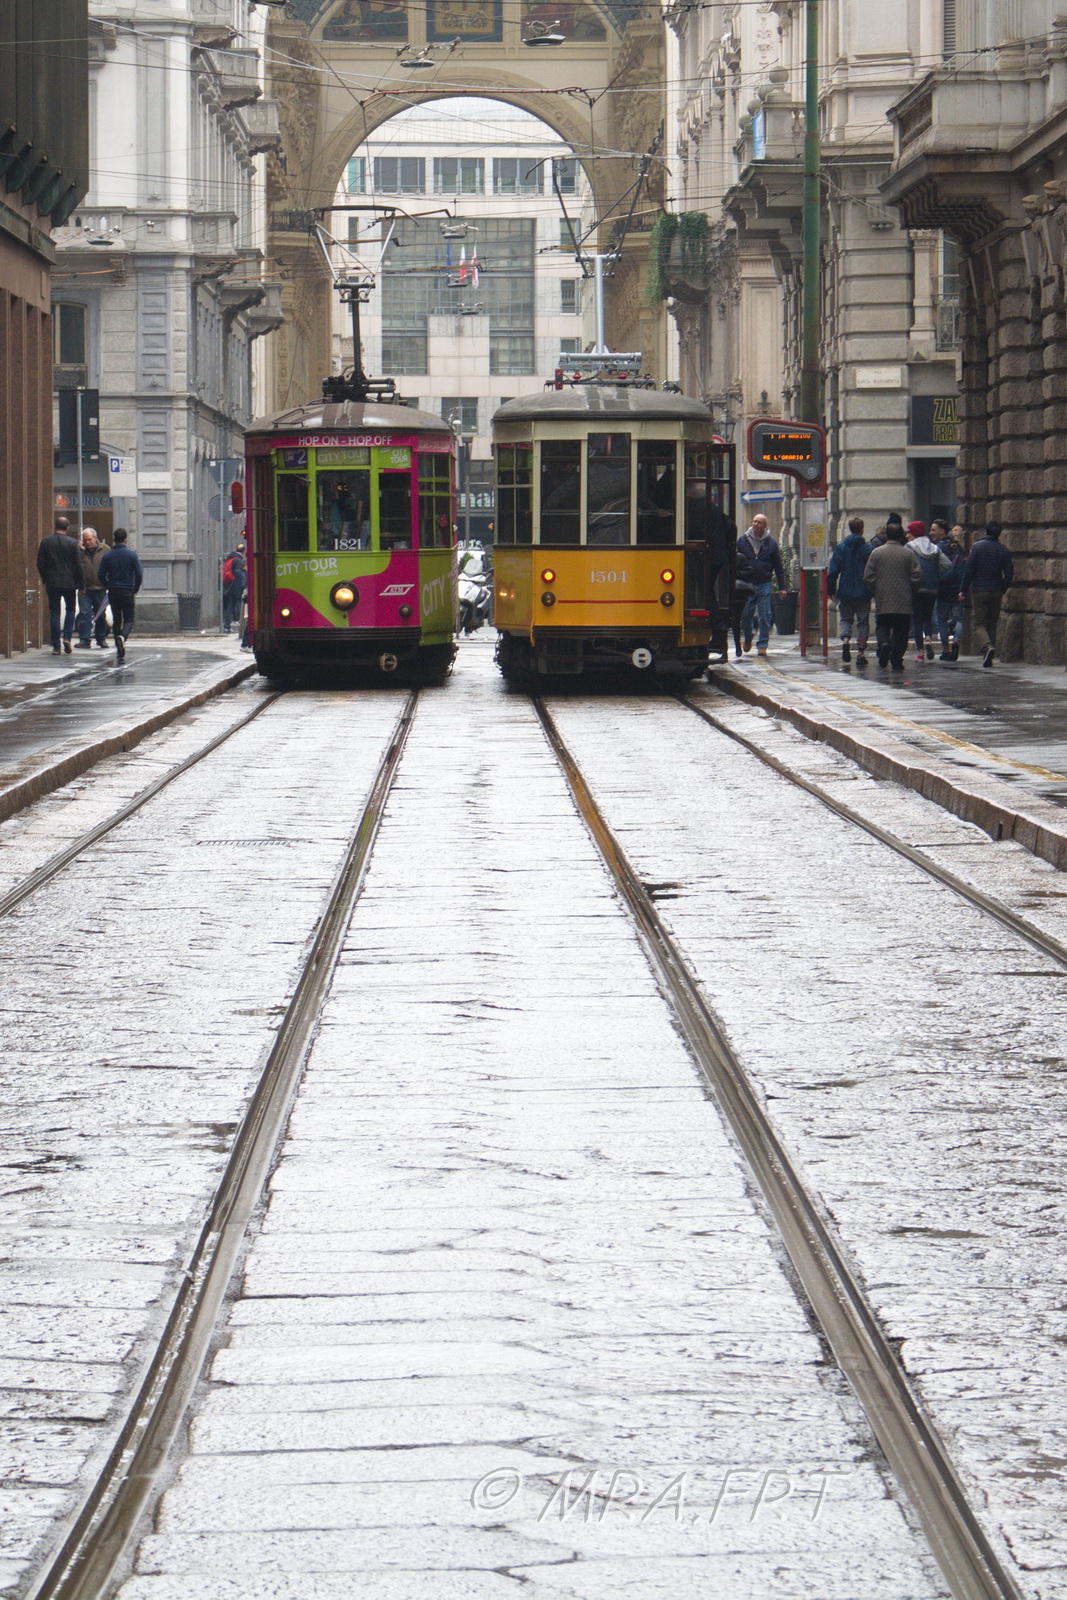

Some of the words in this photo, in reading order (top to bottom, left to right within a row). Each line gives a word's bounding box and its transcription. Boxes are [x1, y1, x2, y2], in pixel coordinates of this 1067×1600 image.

[933, 424, 958, 442] FRA
[298, 436, 320, 446] HOP
[322, 436, 339, 446] ON
[348, 436, 372, 446] HOP
[373, 435, 393, 446] OFF
[298, 449, 307, 464] 2
[317, 452, 340, 463] CITY
[341, 447, 369, 460] TOUR
[392, 448, 407, 456] CITY
[390, 455, 409, 463] TOUR
[71, 496, 112, 508] DRECT
[334, 538, 361, 550] 1821
[276, 562, 300, 576] CITY
[303, 557, 338, 572] TOUR
[591, 570, 627, 583] 1504
[422, 575, 446, 617] CITY
